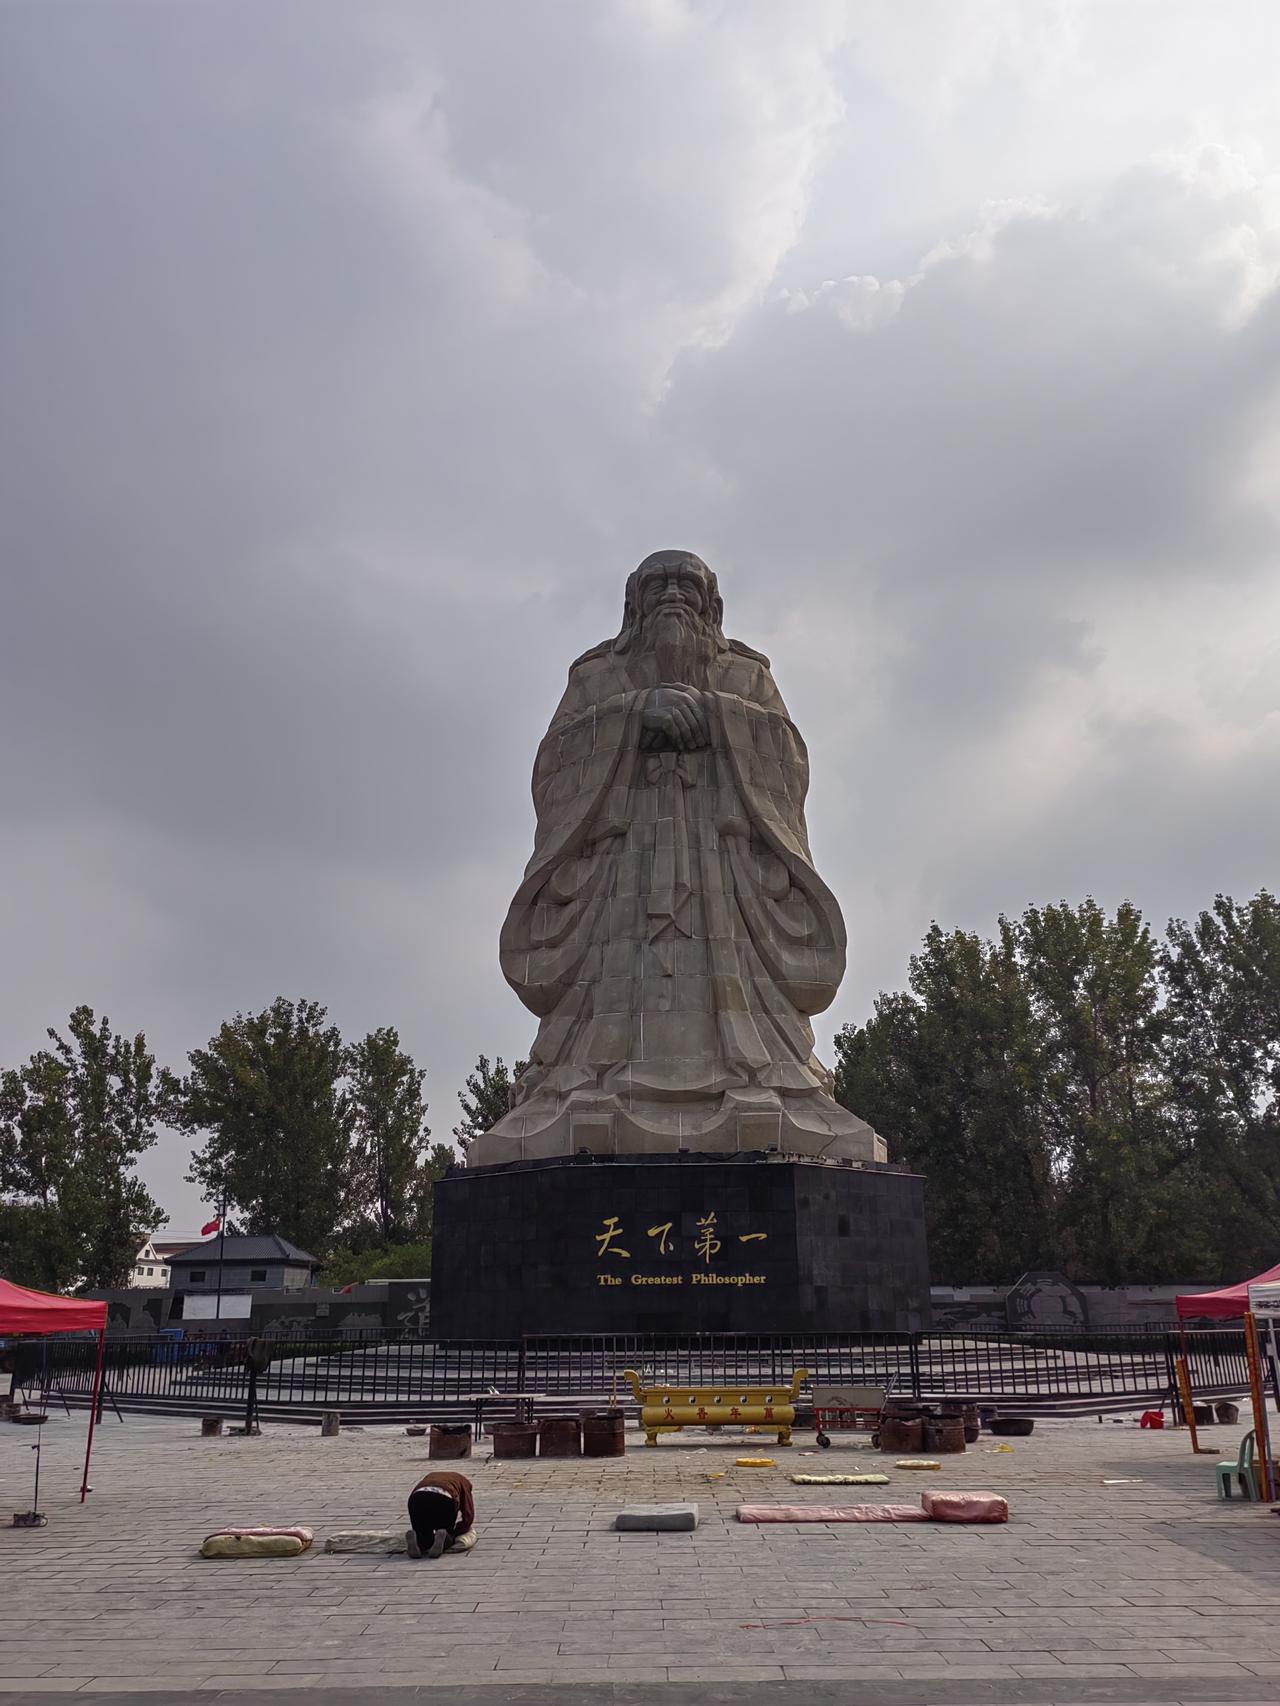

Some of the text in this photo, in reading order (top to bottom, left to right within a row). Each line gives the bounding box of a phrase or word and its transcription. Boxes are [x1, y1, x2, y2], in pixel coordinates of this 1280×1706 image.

[595, 1211, 768, 1263] 天下第一
[597, 1273, 766, 1286] The Greatest Philosopher
